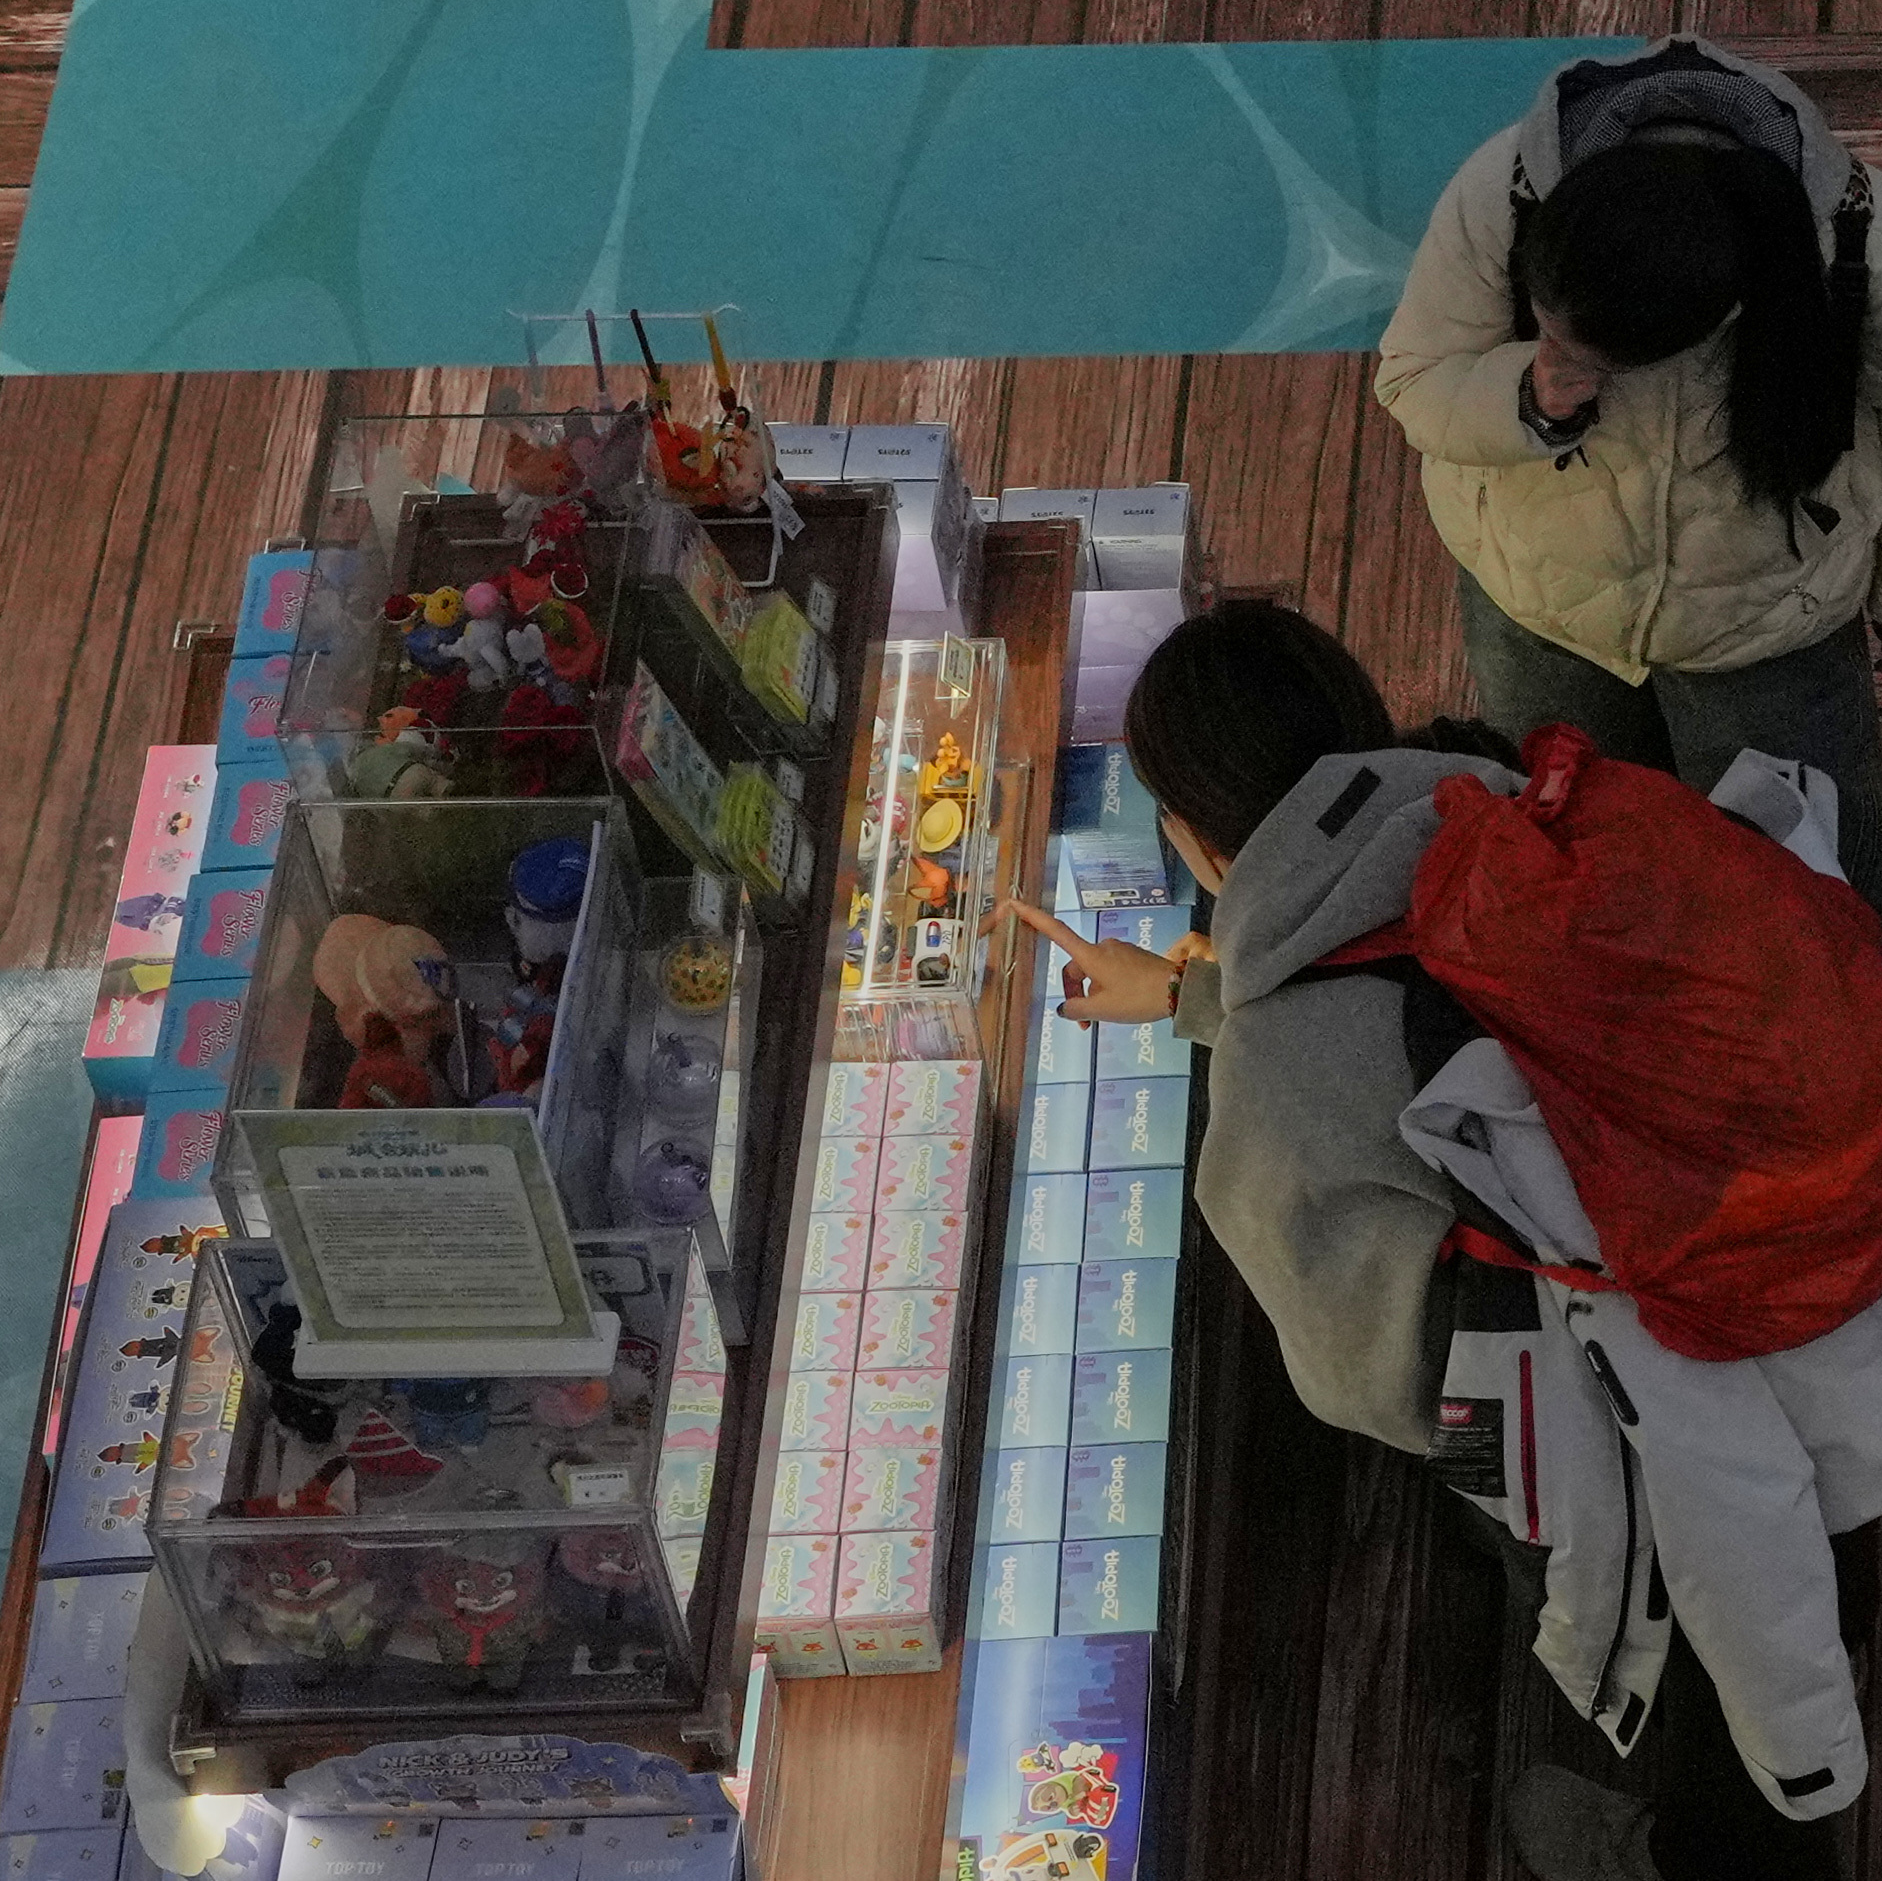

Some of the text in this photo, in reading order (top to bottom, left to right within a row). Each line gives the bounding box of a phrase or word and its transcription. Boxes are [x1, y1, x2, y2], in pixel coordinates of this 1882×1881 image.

[239, 889, 265, 939] Flower
[216, 1000, 241, 1051] Flower
[198, 1111, 223, 1162] Flower
[1030, 1095, 1049, 1160] ZOOTOPIA
[1131, 1088, 1150, 1153] ZOOTOPIA
[1027, 1186, 1047, 1252] ZOOTOPIA
[1126, 1181, 1145, 1247] ZOOTOPIA
[1019, 1276, 1038, 1344] ZOOTOPIA
[1118, 1270, 1137, 1338] ZOOTOPIA
[1013, 1367, 1032, 1435] ZOOTOPIA
[1114, 1362, 1132, 1431] ZOOTOPIA
[1005, 1459, 1025, 1529] ZOOTOPIA
[1108, 1455, 1127, 1524] ZOOTOPIA
[999, 1556, 1017, 1628] ZOOTOPIA
[1101, 1550, 1120, 1621] ZOOTOPIA
[378, 1752, 442, 1769] NICK
[476, 1747, 571, 1766] JUDY'S
